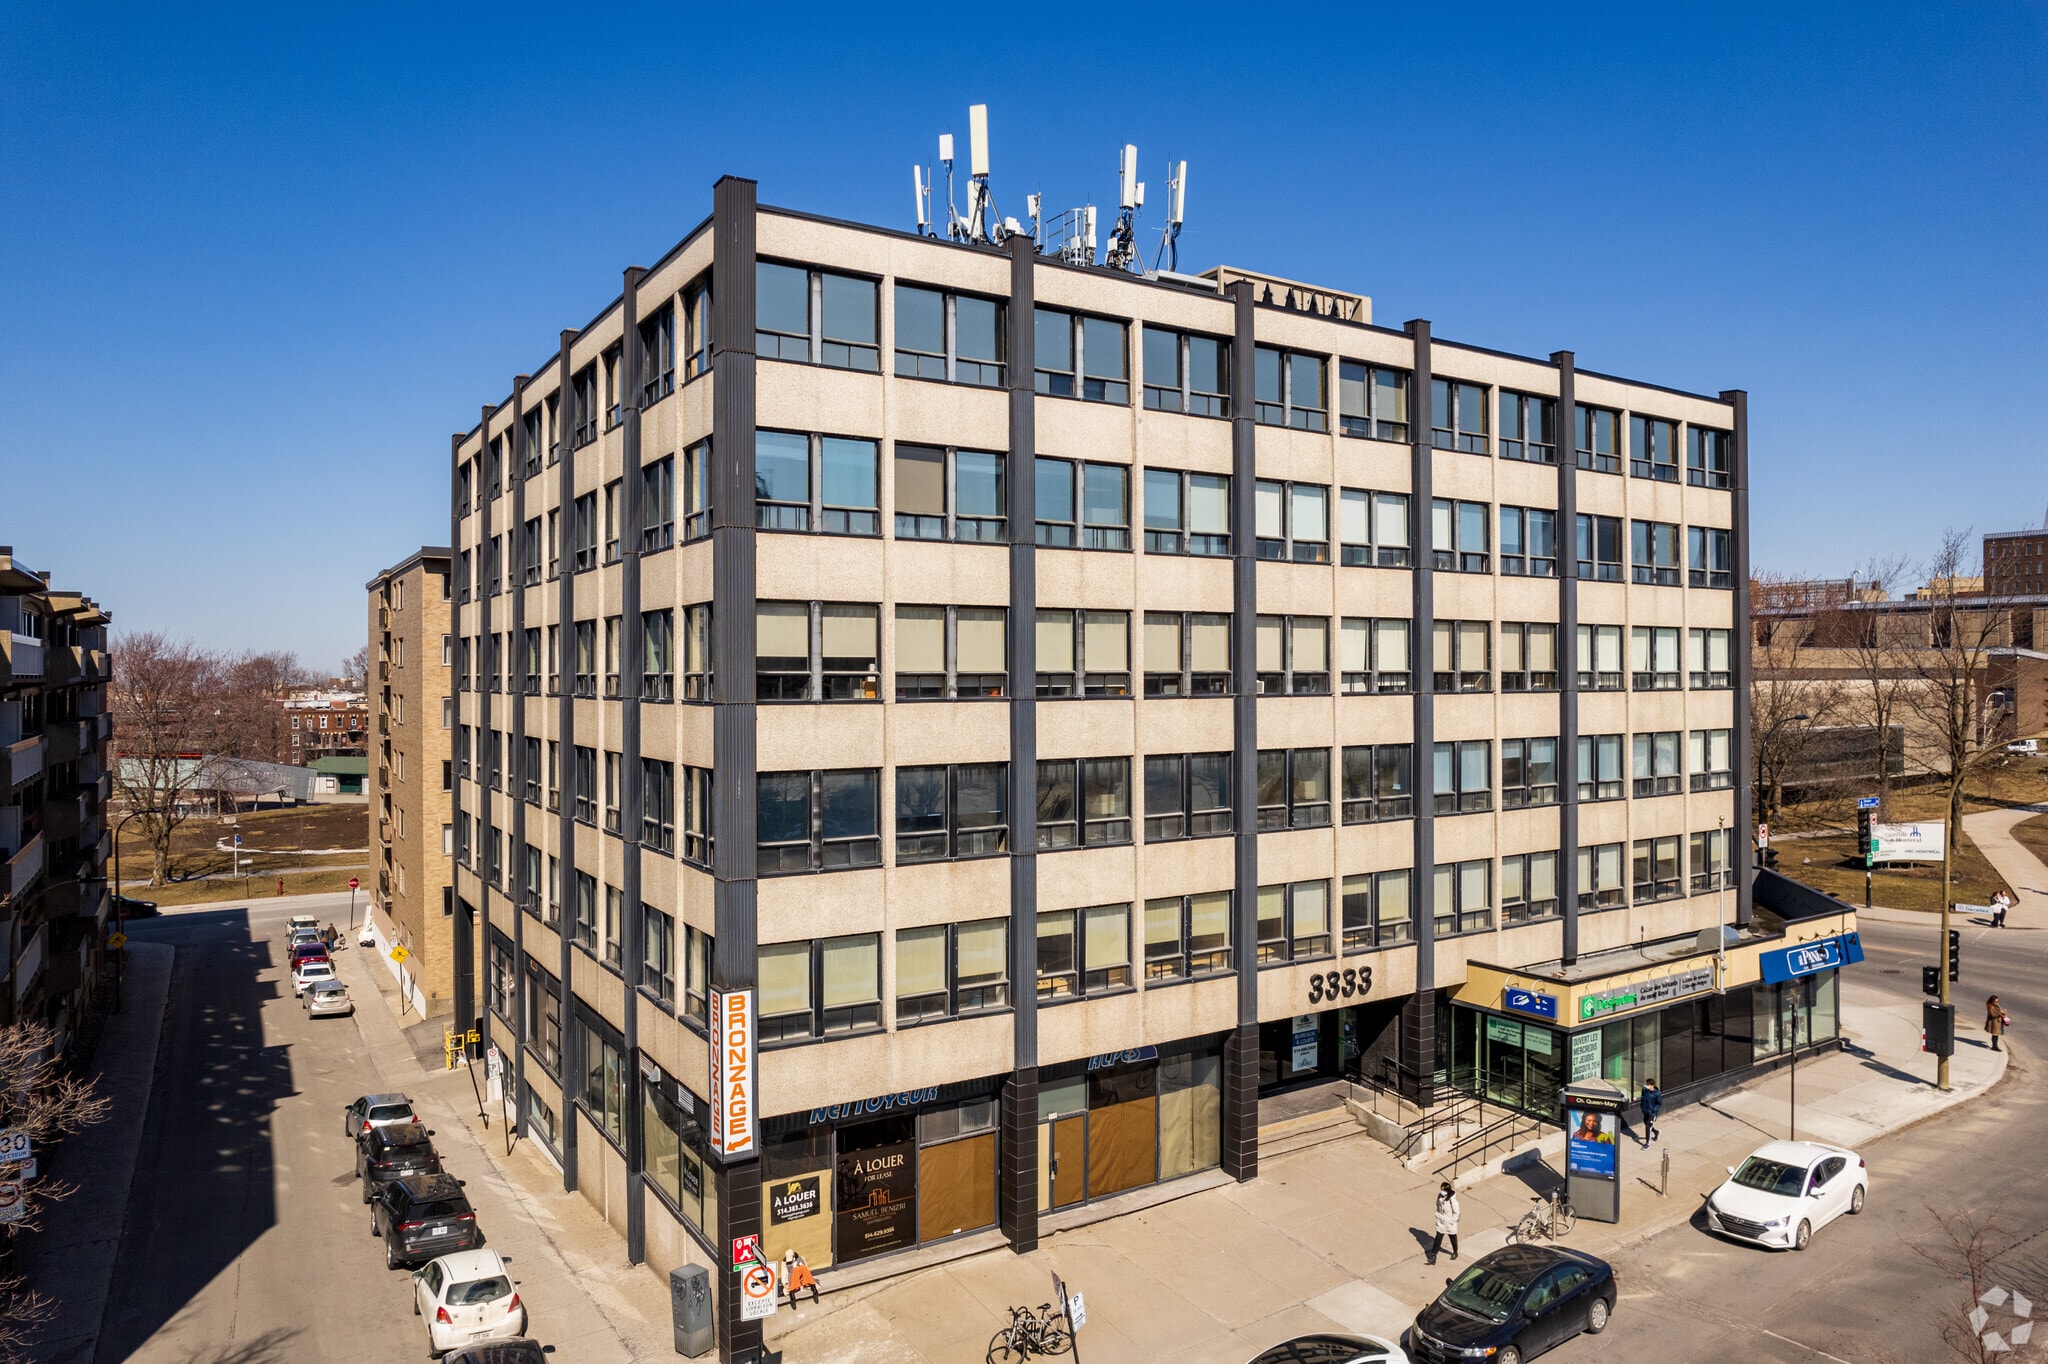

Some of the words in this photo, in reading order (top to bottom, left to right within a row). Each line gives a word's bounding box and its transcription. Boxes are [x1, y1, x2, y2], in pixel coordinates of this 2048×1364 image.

[1308, 966, 1372, 1005] 3333
[1597, 992, 1638, 1011] Desjardins
[1573, 1035, 1590, 1046] OUVERT
[1591, 1033, 1599, 1042] LES
[1573, 1042, 1598, 1056] MERCREDIS
[712, 993, 721, 1134] BRONZAGE
[729, 994, 747, 1136] BRONZAGE
[1573, 1057, 1579, 1066] ET
[1579, 1053, 1595, 1065] JEUDIS
[1586, 1099, 1618, 1108] Queen-Mary
[854, 1160, 864, 1175] À
[866, 1154, 905, 1173] LOUER
[864, 1174, 876, 1182] FOR
[876, 1171, 894, 1180] LEASE
[774, 1196, 782, 1207] À
[783, 1190, 817, 1206] LOUER
[852, 1208, 879, 1221] SAMUEL
[880, 1202, 906, 1214] BENIZRI
